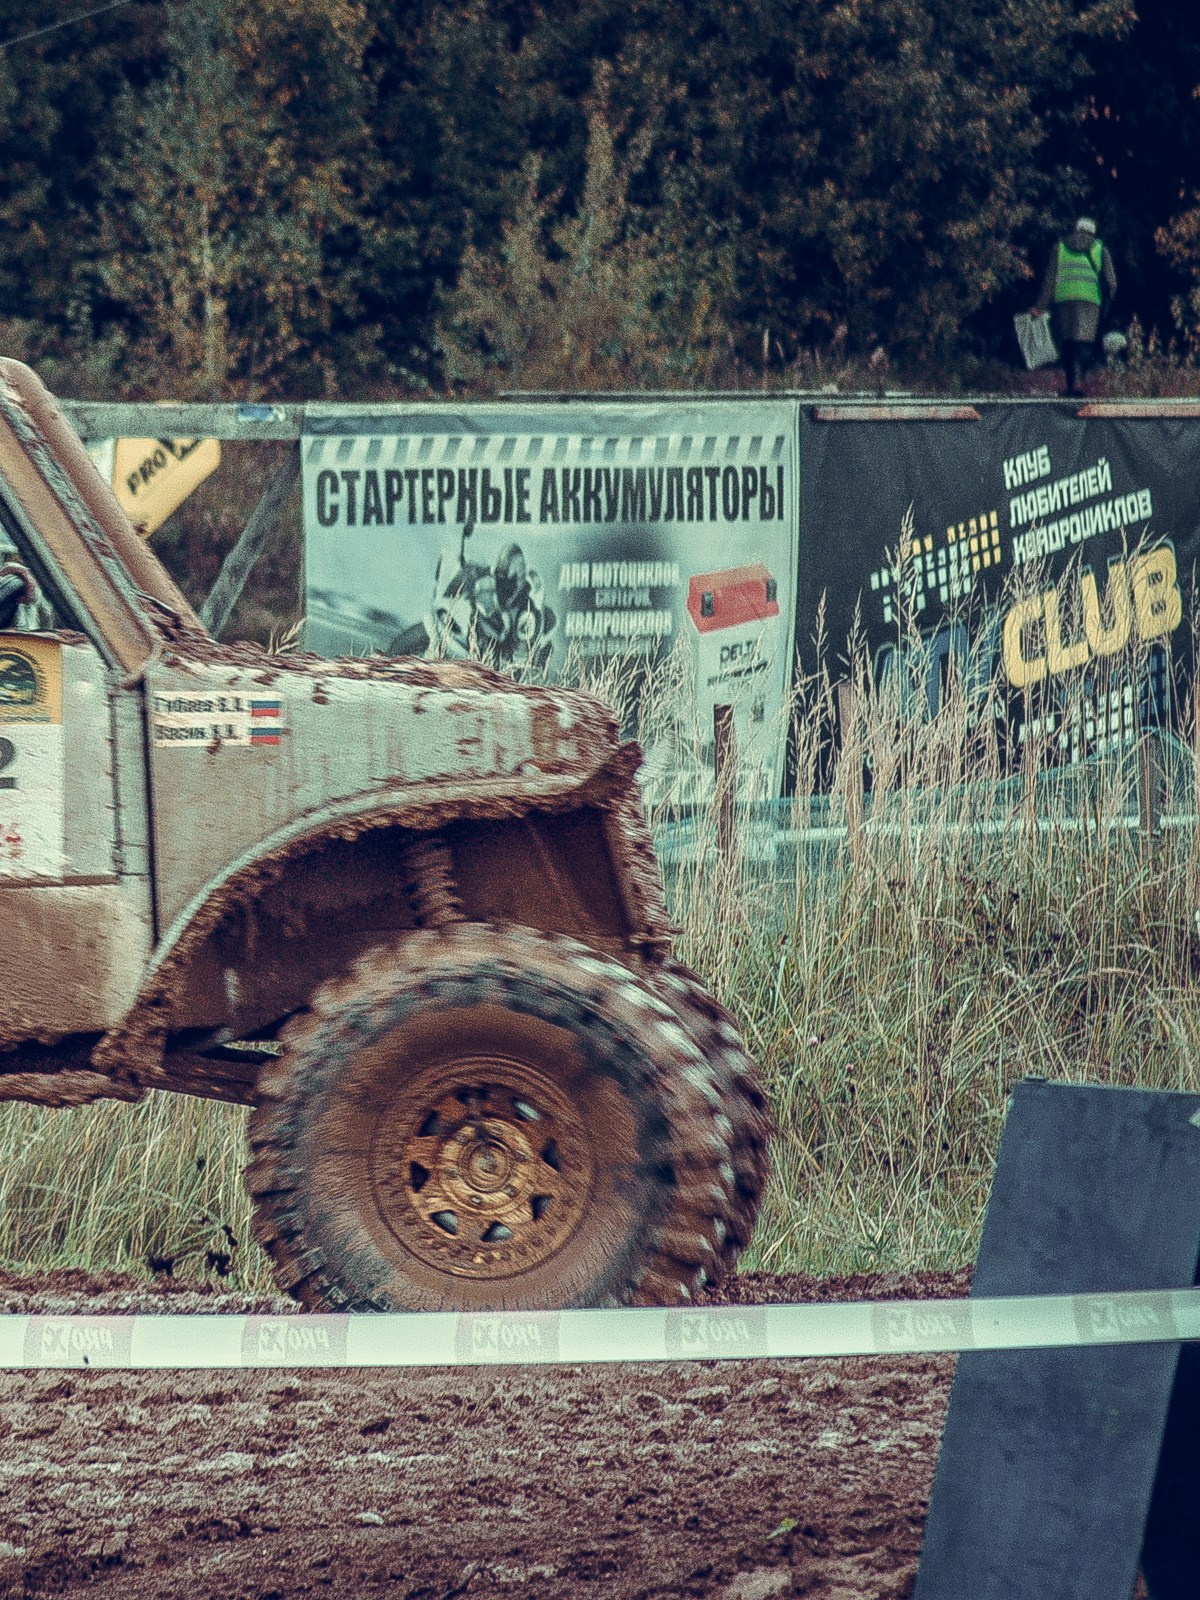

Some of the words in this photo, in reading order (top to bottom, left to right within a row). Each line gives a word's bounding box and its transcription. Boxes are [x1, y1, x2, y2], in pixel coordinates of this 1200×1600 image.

[315, 465, 532, 527] СТАРТЕРНЫЕ
[539, 464, 786, 523] АККУМУЛЯТОРЫ
[1003, 445, 1051, 490] КЛУБ
[1009, 458, 1113, 528] ЛЮБИТЕЛЕЙ
[1003, 540, 1183, 689] CLUB
